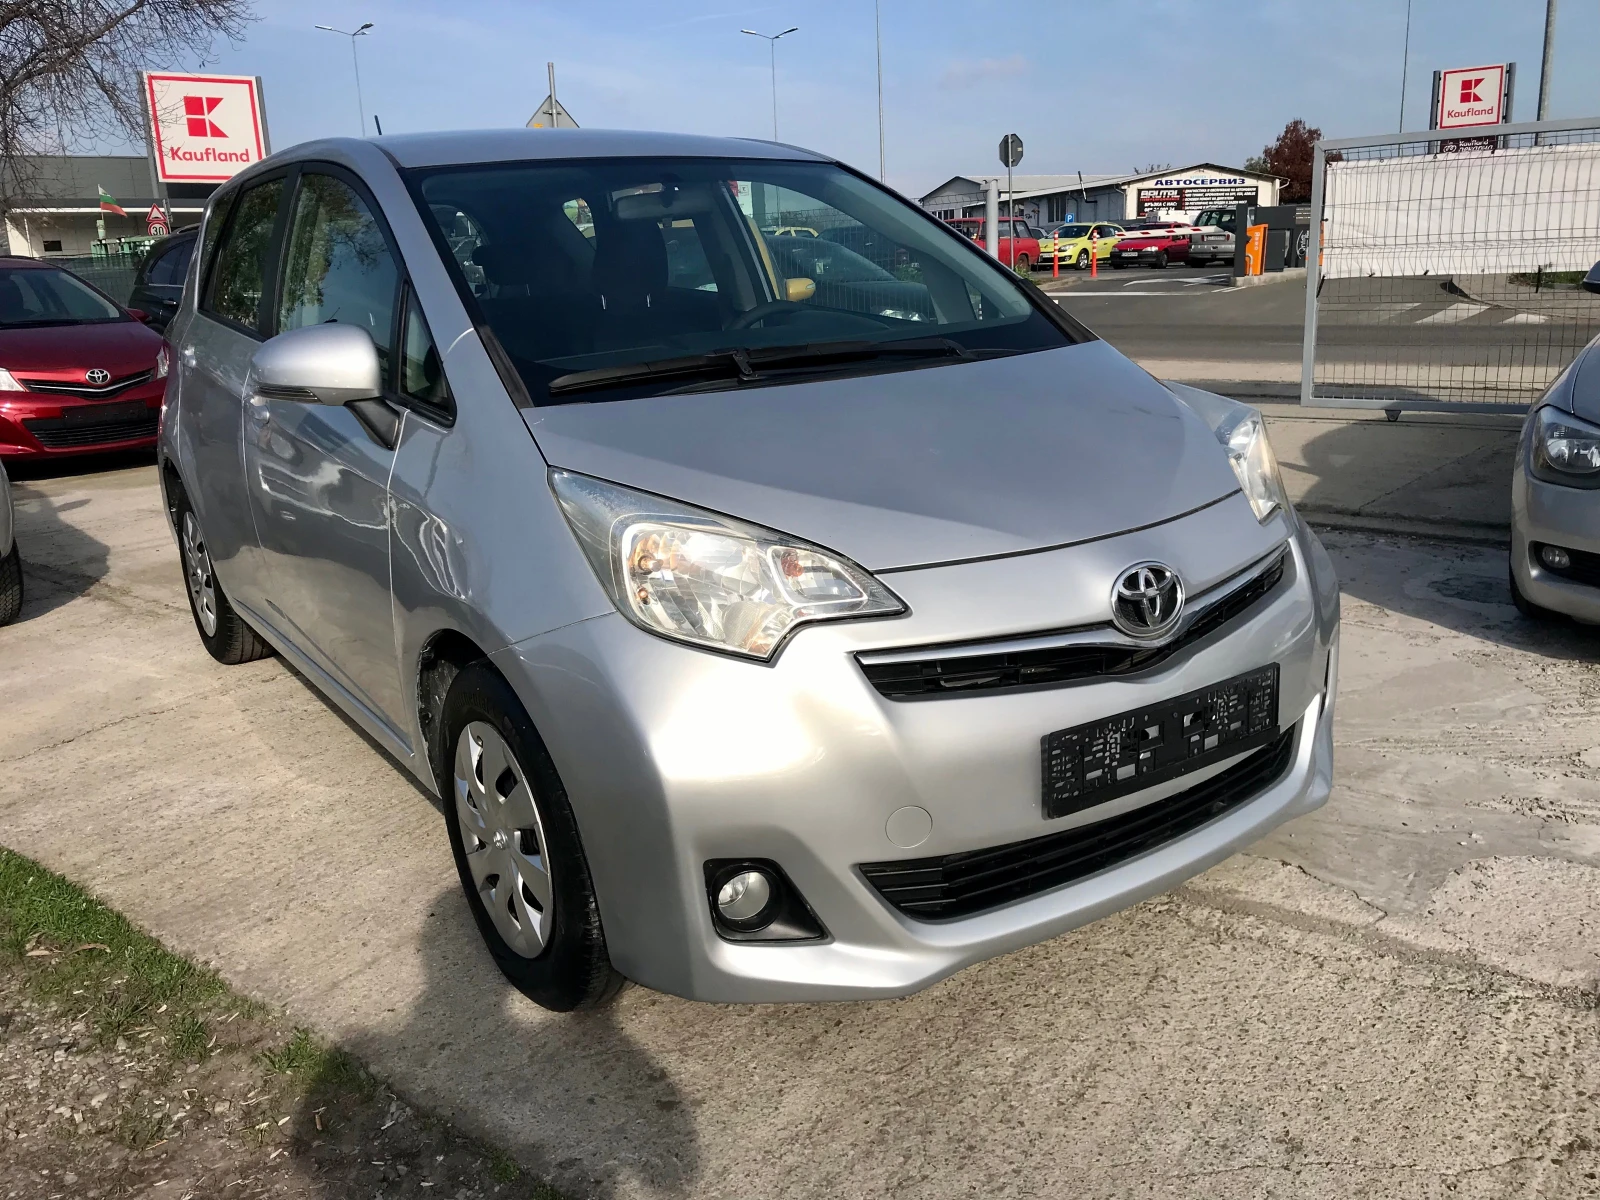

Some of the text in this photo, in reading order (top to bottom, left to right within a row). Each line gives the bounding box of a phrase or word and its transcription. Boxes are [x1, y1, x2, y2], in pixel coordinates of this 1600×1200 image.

[1447, 106, 1494, 118] Kaufland
[1459, 139, 1489, 147] Kaufland
[169, 146, 250, 162] Kaufland
[1154, 178, 1246, 186] АВТОСЕРВИЗ
[152, 226, 164, 236] 30
